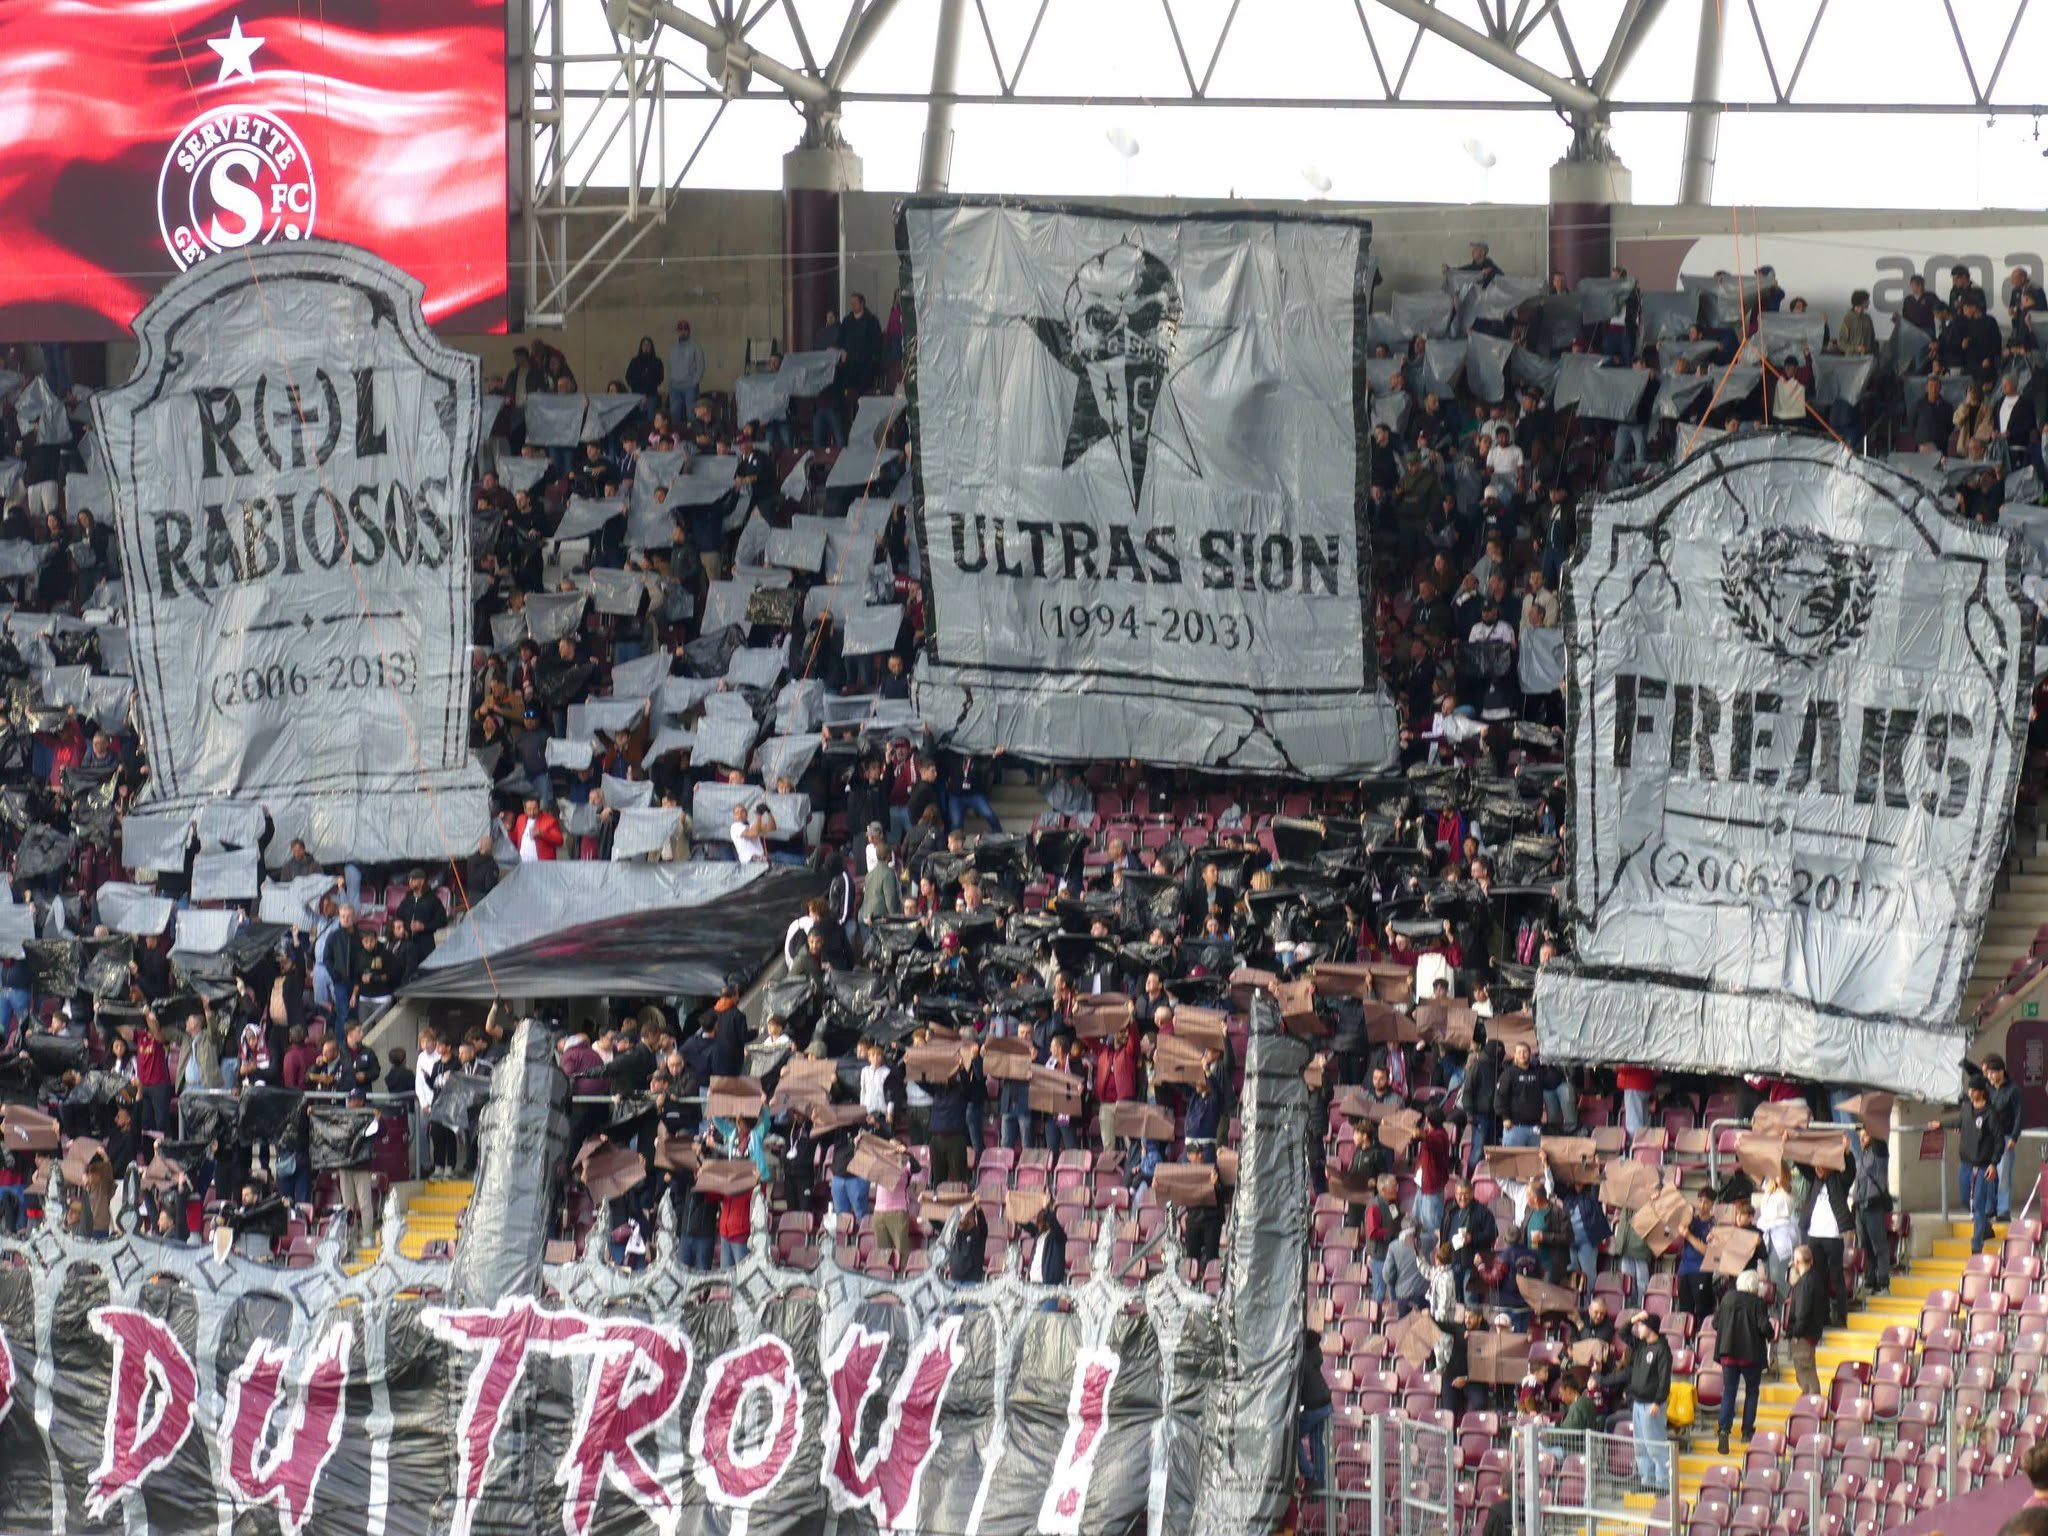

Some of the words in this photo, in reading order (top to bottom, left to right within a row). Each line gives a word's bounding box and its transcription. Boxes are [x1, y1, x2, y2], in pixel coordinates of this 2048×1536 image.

[177, 115, 297, 173] SERVETTE
[209, 150, 263, 247] S
[270, 183, 309, 214] FC
[151, 477, 453, 607] RABIOSOS
[947, 511, 1182, 585] ULTRAS
[1200, 528, 1341, 597] SION
[1038, 599, 1256, 653] (1994-2013)
[211, 649, 418, 715] (2006-2013)
[1613, 673, 1973, 818] FREAKS
[85, 1304, 353, 1527] DU
